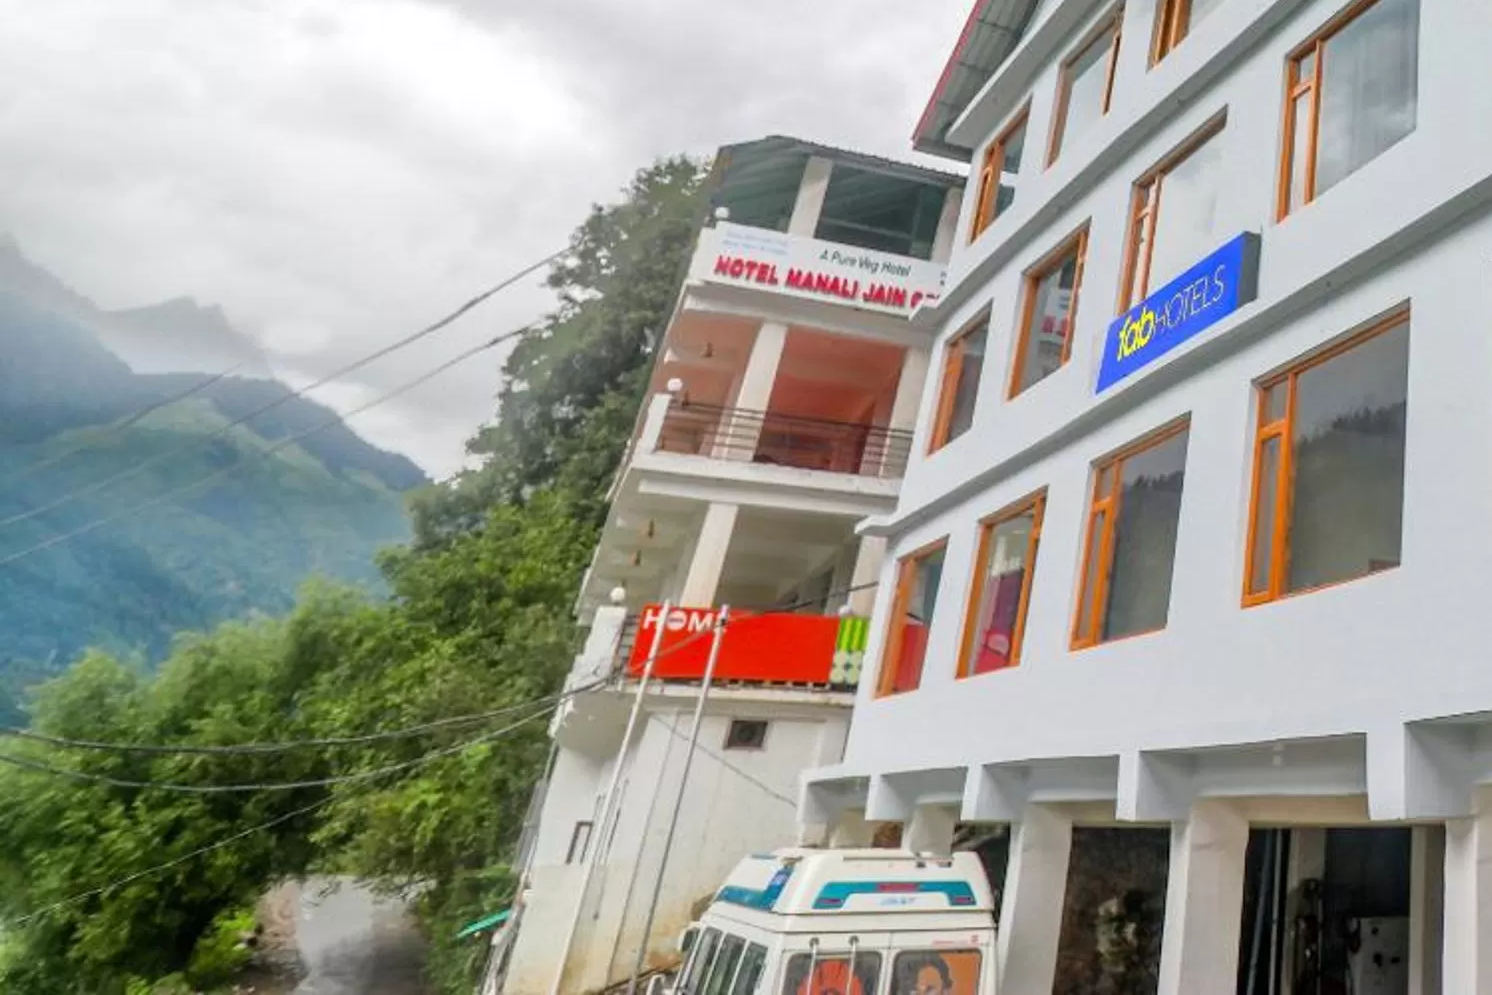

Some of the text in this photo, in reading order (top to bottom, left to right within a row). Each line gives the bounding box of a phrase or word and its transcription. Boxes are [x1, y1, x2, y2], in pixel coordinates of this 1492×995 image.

[714, 254, 778, 285] HOTEL
[785, 267, 859, 300] MANALI
[863, 282, 907, 307] JAIN
[831, 250, 857, 267] Pure
[858, 255, 879, 274] Veg
[881, 260, 911, 277] Hotel
